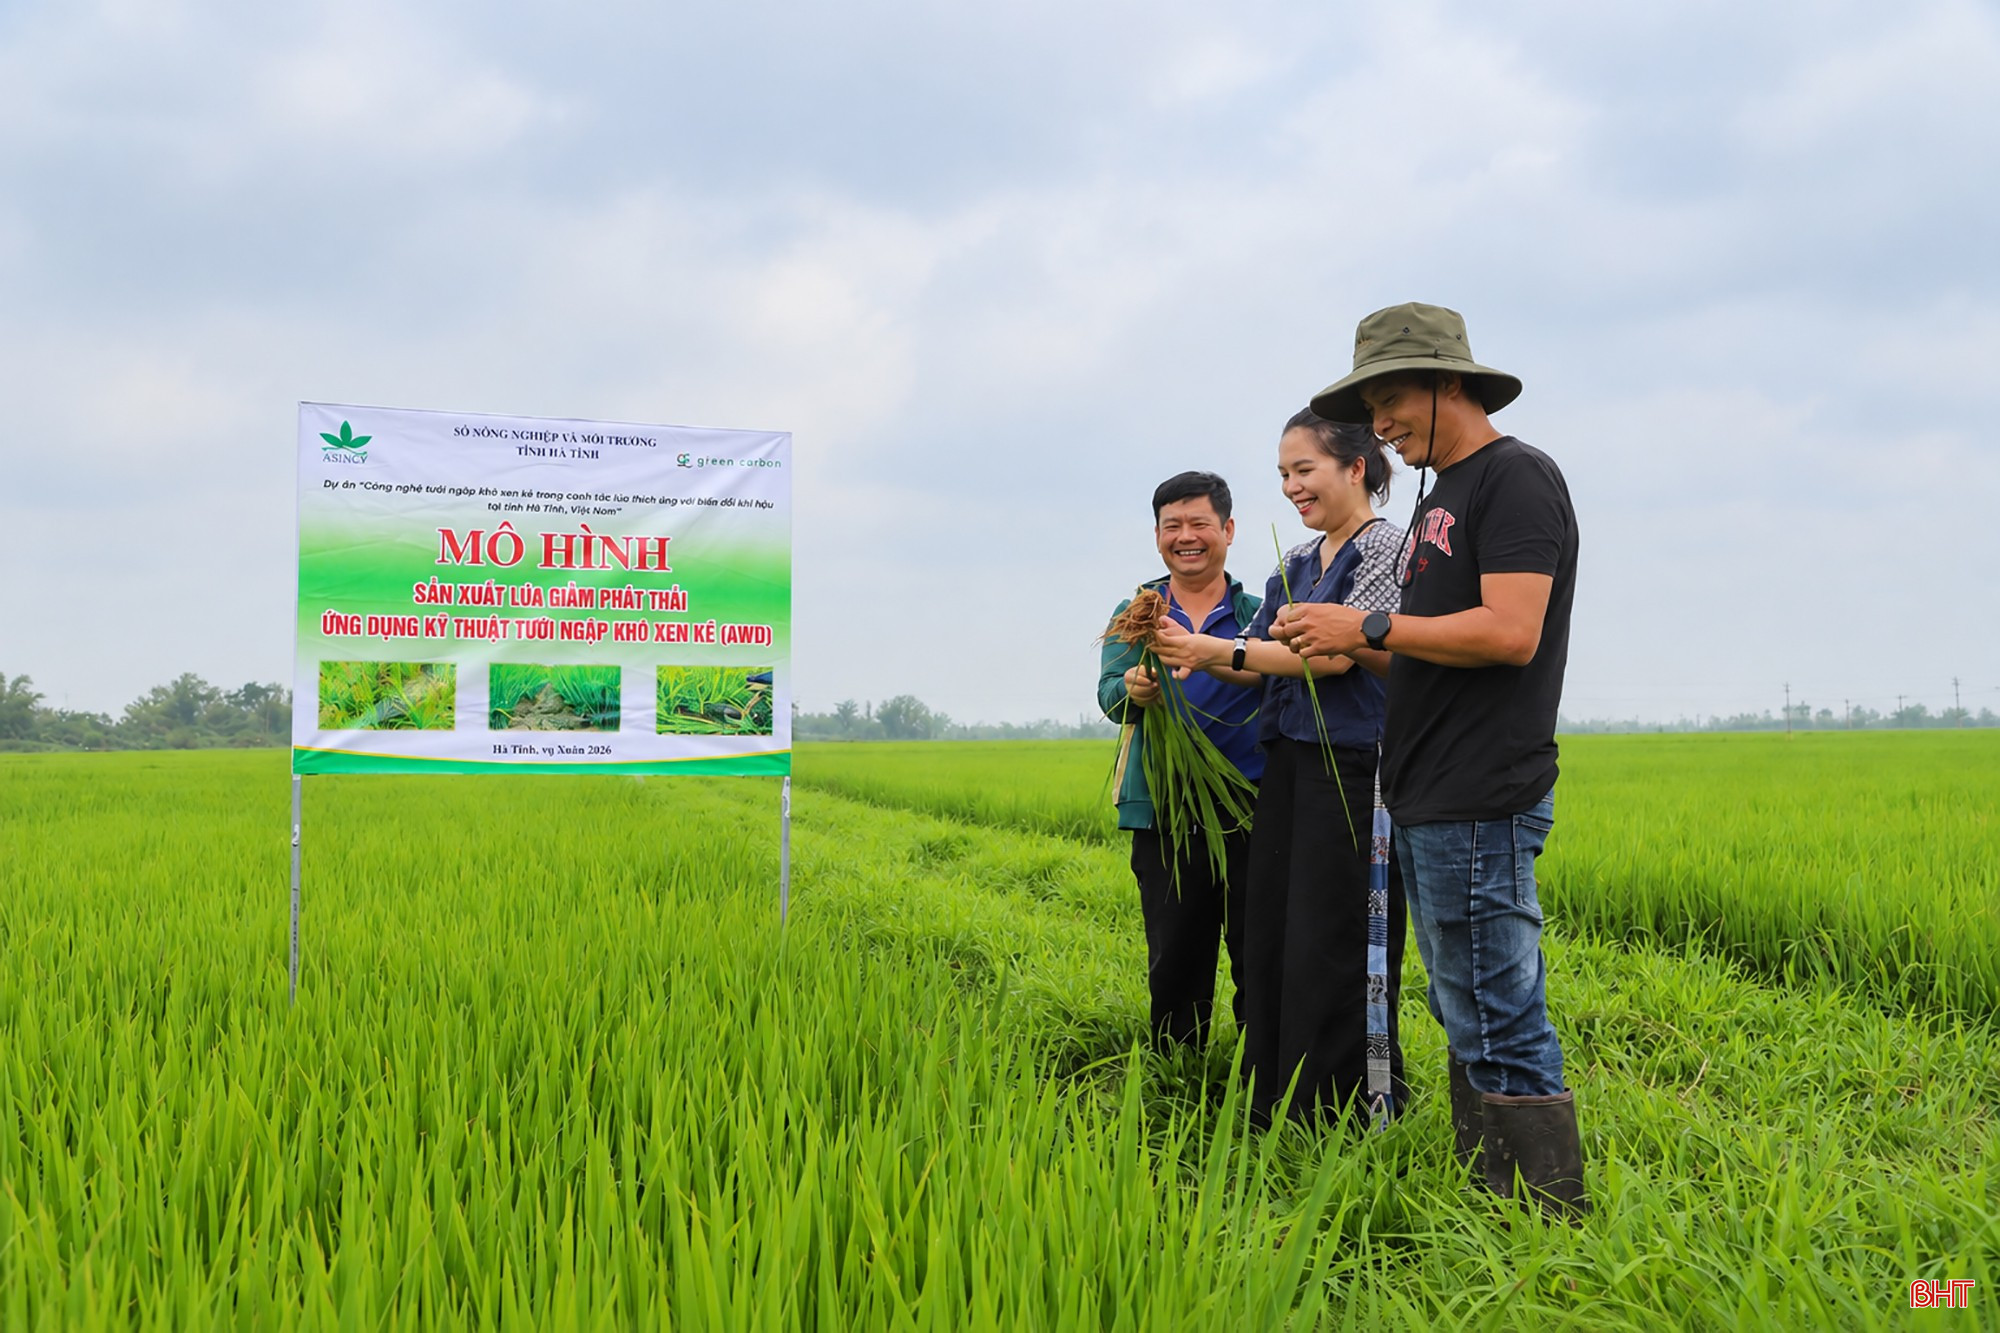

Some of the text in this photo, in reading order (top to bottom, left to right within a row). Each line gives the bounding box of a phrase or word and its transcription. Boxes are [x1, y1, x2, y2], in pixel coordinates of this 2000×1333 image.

[322, 453, 368, 464] ASINCY
[698, 456, 734, 468] green
[740, 458, 781, 468] carbon
[536, 491, 563, 502] trong
[566, 492, 592, 500] canh
[436, 520, 672, 572] MÔ HÌNH
[414, 576, 688, 612] SẢN XUẤT LÚA GIẢM PHÁT THẢI
[322, 609, 362, 636] ỨNG
[367, 616, 418, 642] DỤNG
[424, 612, 449, 638] KỸ
[454, 614, 510, 643] THUẬT
[515, 617, 555, 640] TƯỚI
[560, 617, 609, 646] NGẬP
[614, 618, 648, 642] KHÔ
[654, 622, 689, 643] XEN
[721, 624, 772, 647] (AWD)
[493, 744, 508, 754] Hà
[588, 745, 612, 754] 2026
